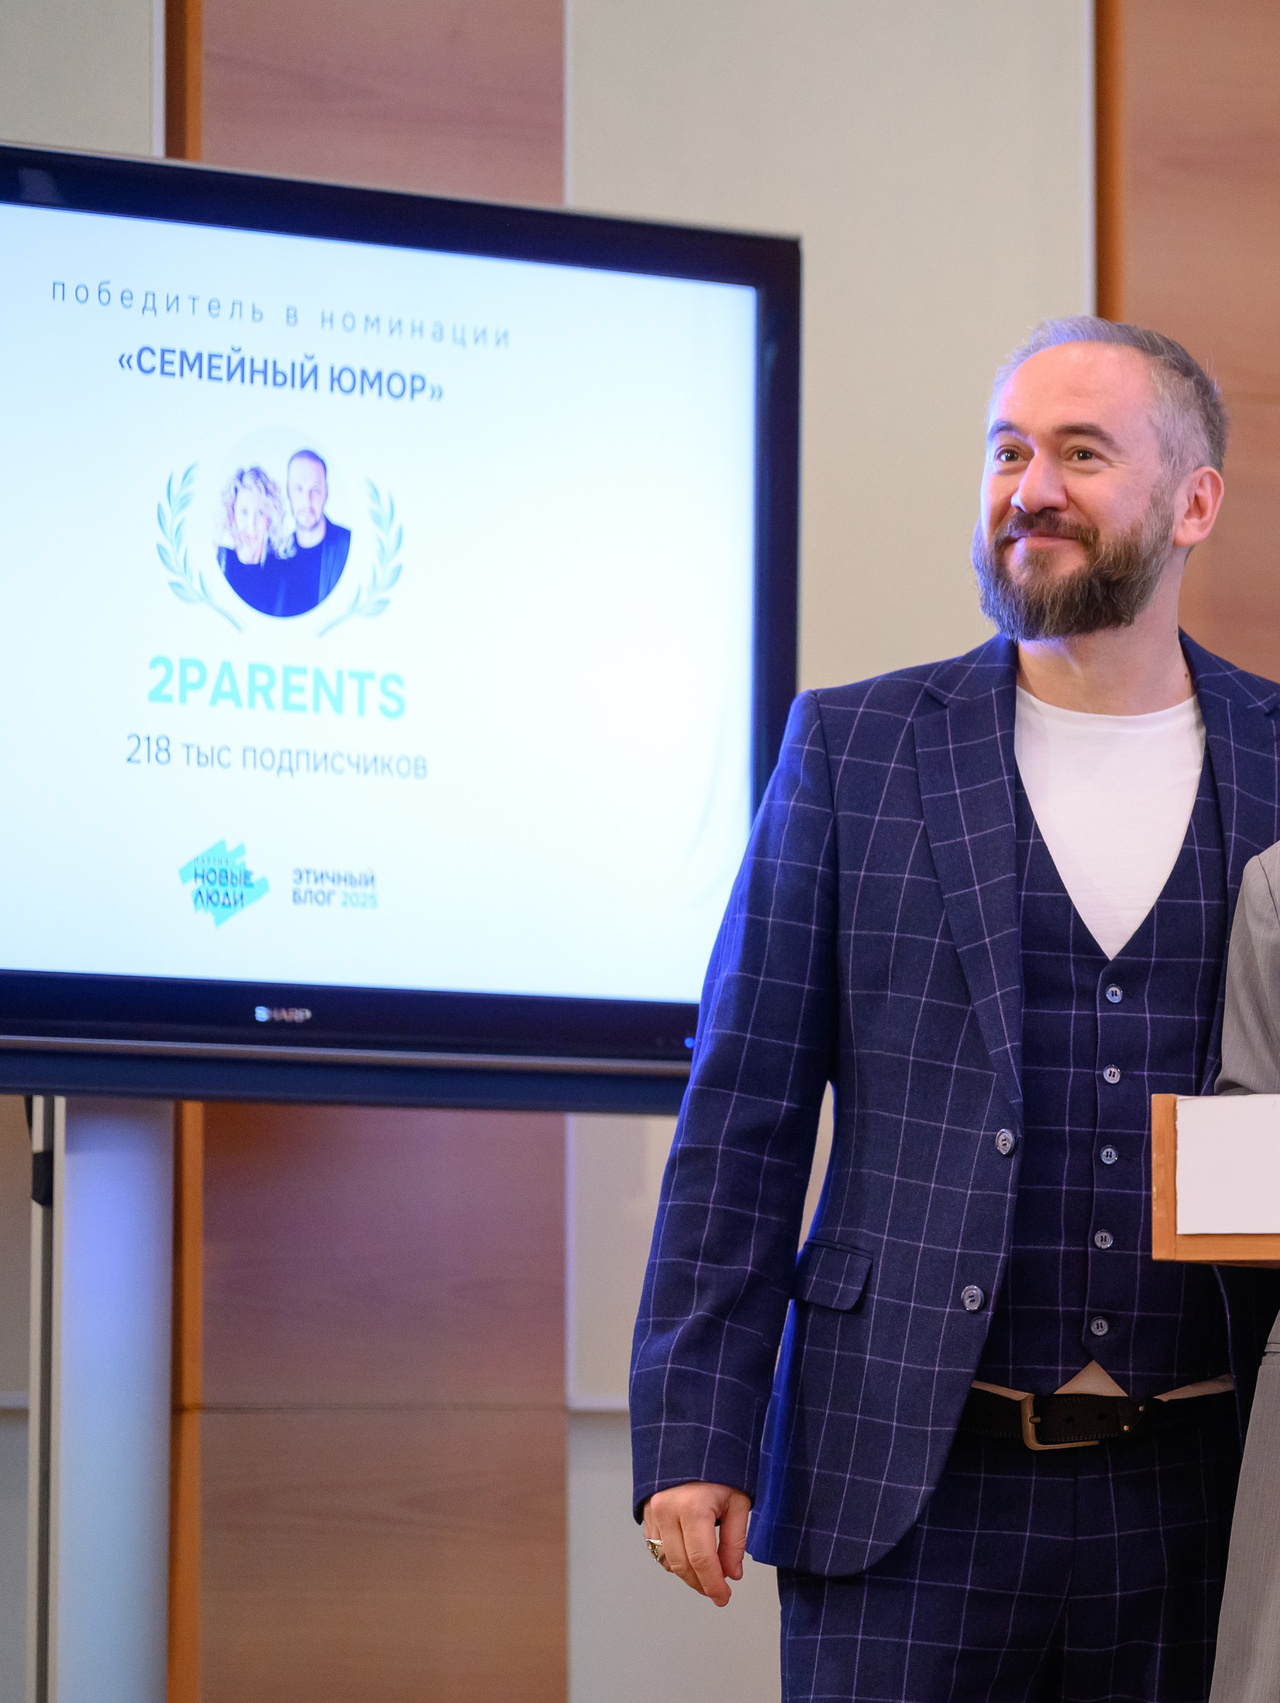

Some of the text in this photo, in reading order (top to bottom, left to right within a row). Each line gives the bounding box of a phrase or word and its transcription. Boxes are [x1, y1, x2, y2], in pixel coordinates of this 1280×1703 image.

[51, 280, 512, 349] победитель в номинации
[118, 346, 445, 402] «СЕМЕЙНЫЙ ЮМОР»
[147, 654, 407, 720] 2PARENTS
[126, 733, 428, 780] 218 тыс подписчиков
[194, 866, 255, 889] НОВЫЕ
[292, 867, 376, 889] ЭТИЧНЫЙ
[194, 888, 244, 909] ЛЮДИ
[292, 887, 379, 909] БЛОГ 2025
